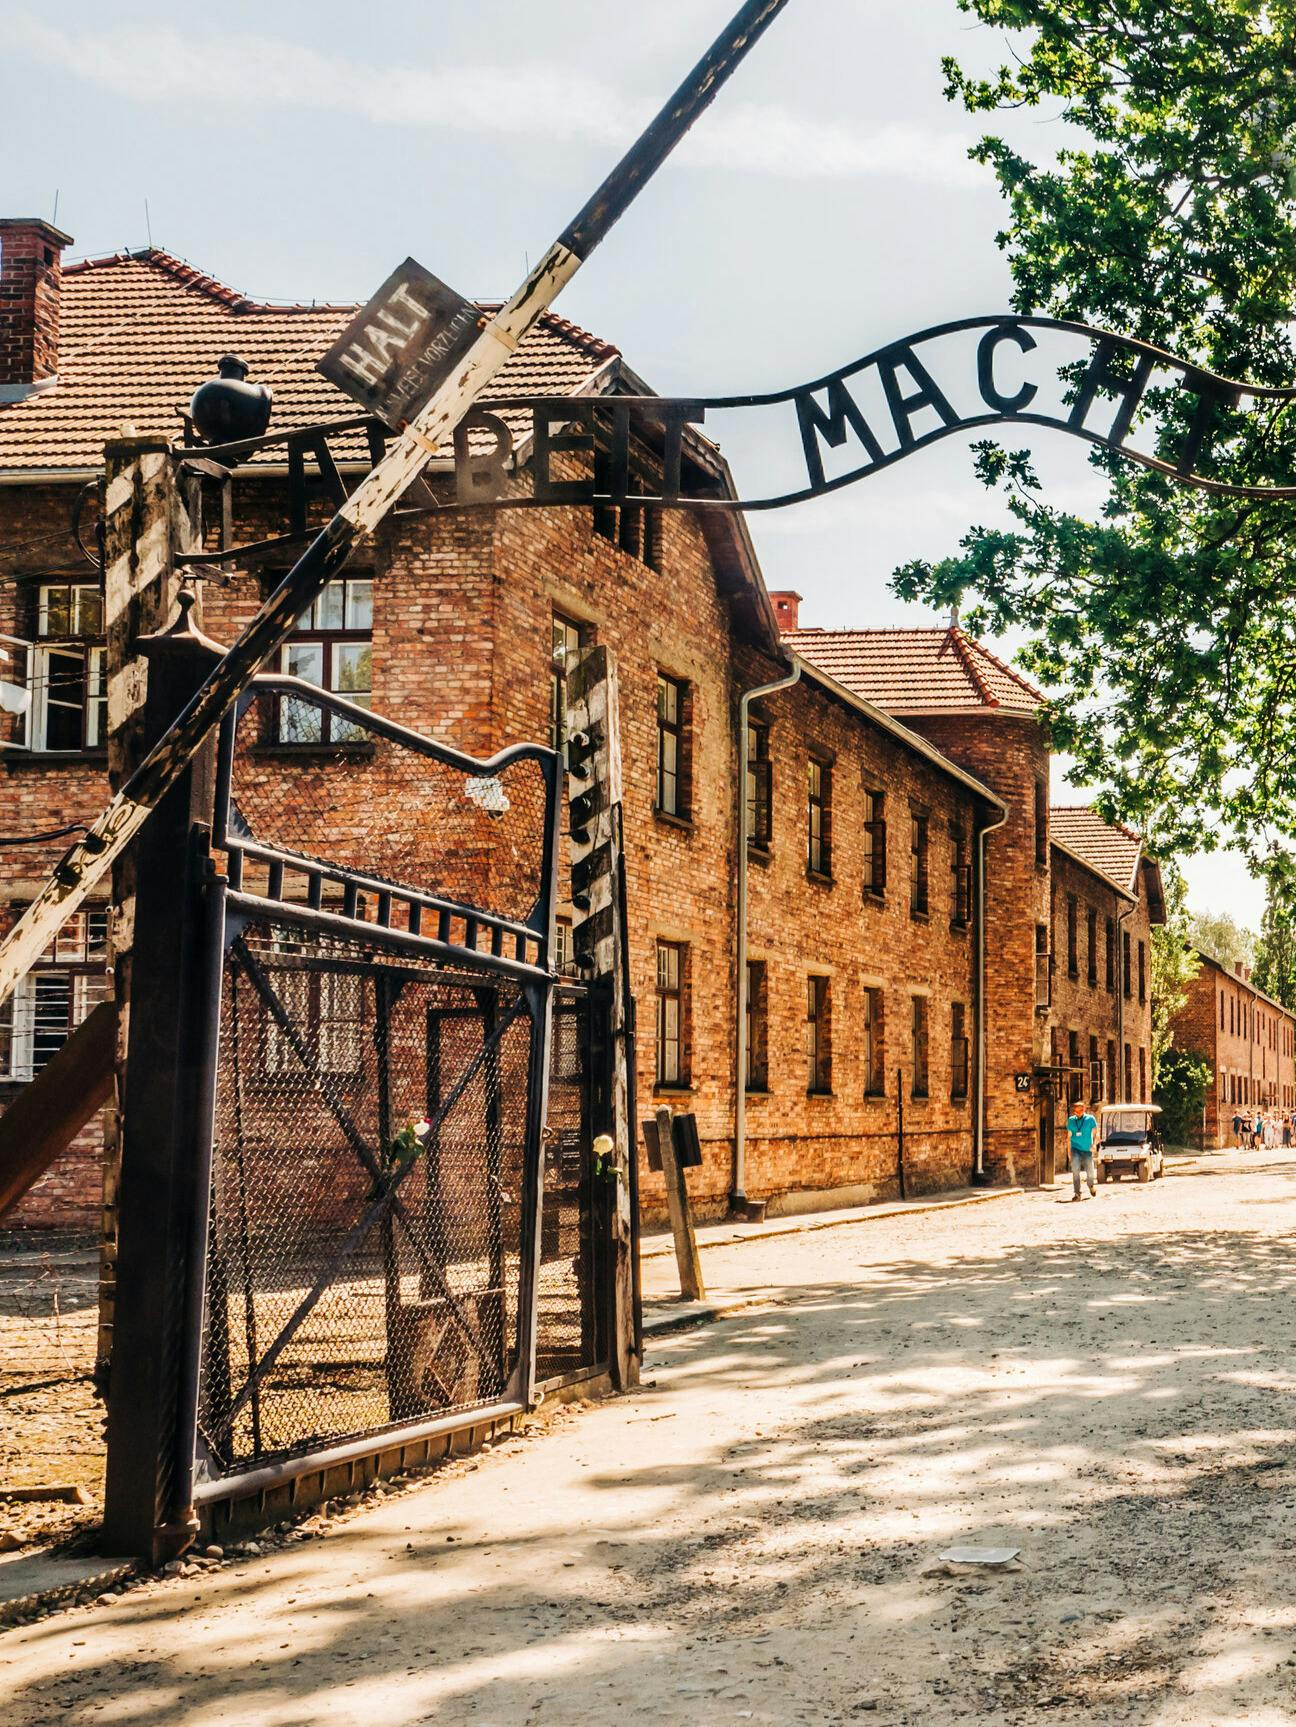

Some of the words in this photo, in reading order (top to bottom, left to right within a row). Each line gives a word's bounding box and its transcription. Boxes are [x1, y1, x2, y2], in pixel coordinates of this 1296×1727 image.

[338, 282, 432, 386] HALT
[375, 363, 426, 425] AWEISE
[795, 324, 1240, 489] MACHT
[1017, 1076, 1030, 1088] 24
